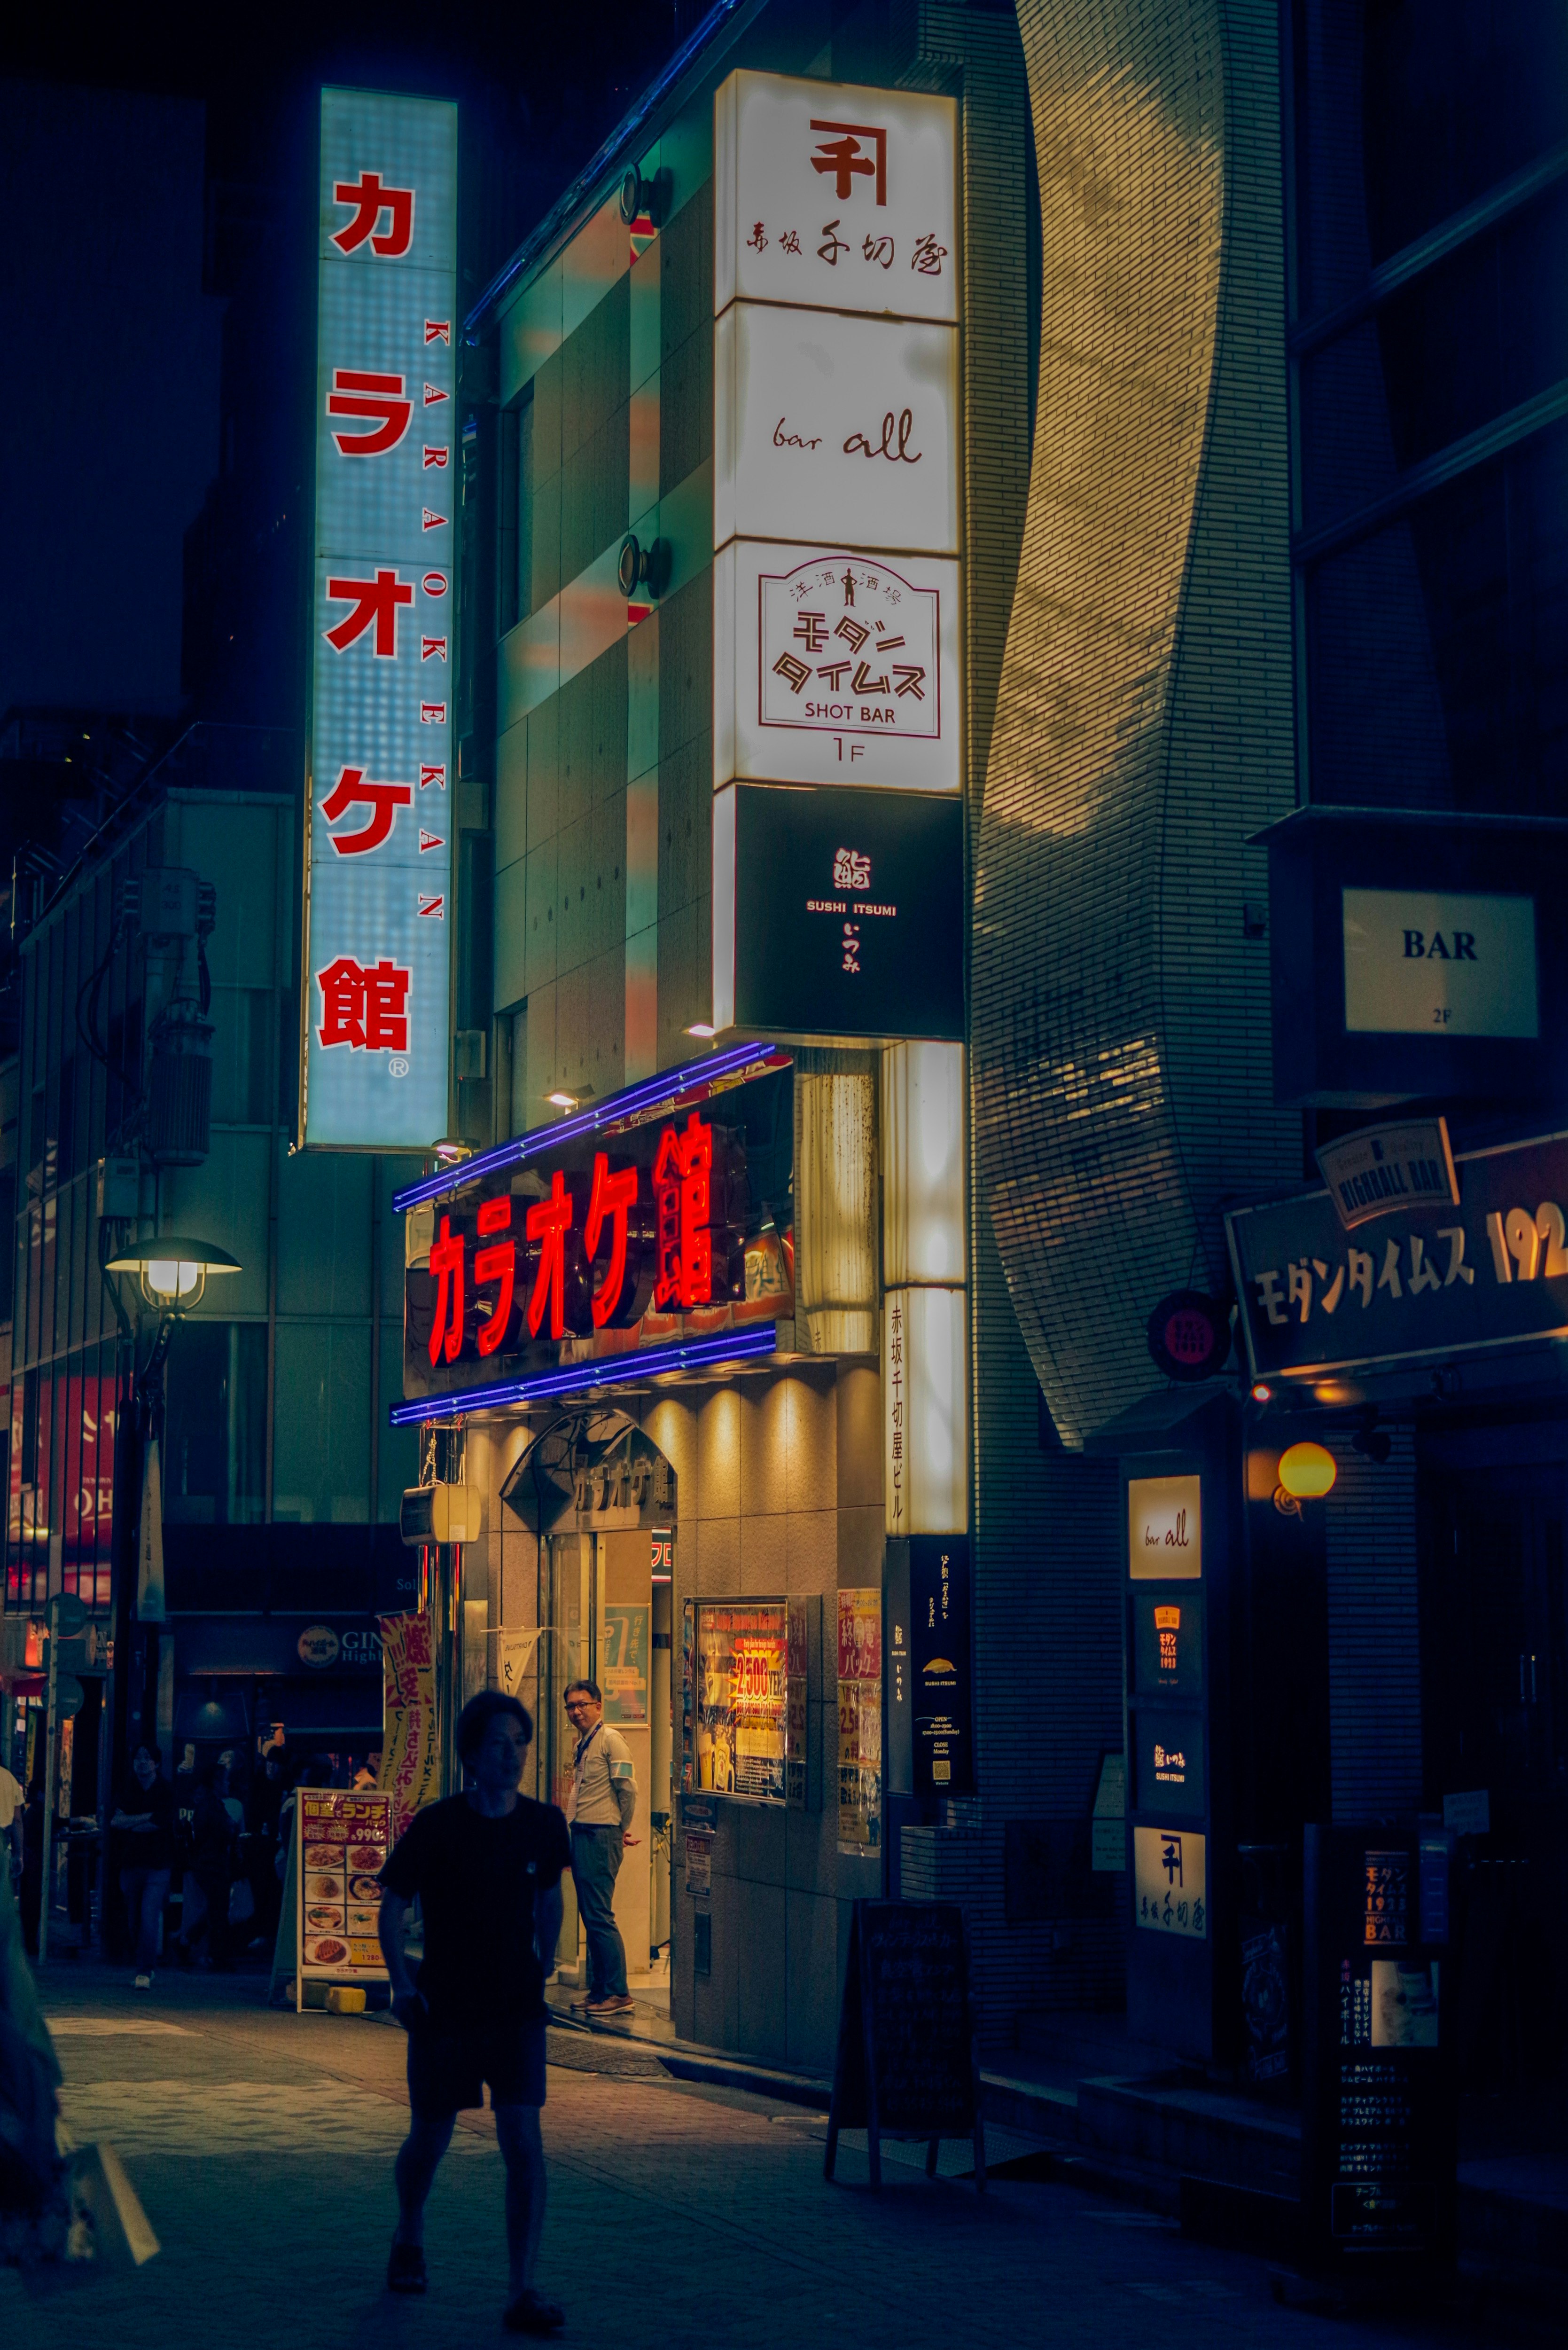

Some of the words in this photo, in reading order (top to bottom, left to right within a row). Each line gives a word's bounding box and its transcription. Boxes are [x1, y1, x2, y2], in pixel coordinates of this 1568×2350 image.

[773, 417, 823, 450] bar
[843, 408, 922, 463] all
[315, 171, 415, 1054] カラオケ館
[416, 319, 450, 919] KARAOKEKAN
[793, 611, 906, 655] モダン
[772, 651, 926, 701] タイムス
[805, 703, 853, 720] SHOT
[860, 707, 896, 724] BAR
[806, 901, 846, 913] SUSHI
[853, 903, 897, 916] ITSUMI
[842, 922, 861, 973] いつみ
[1403, 930, 1478, 961] BAR
[1433, 1009, 1452, 1024] 2F
[1338, 1163, 1409, 1212] HIGHBALL
[1408, 1159, 1443, 1191] BAR
[429, 1112, 713, 1368] カラオケ館
[1255, 1226, 1474, 1325] モダンタイムス
[891, 1305, 903, 1519] 赤坂千切屋ビル
[1145, 1525, 1159, 1546] bar
[1165, 1508, 1189, 1547] all
[1156, 1772, 1170, 1781] SUSHI
[1170, 1773, 1185, 1783] ITSUMI
[1365, 1865, 1407, 1882] モダン
[1365, 1924, 1406, 1940] BAR
